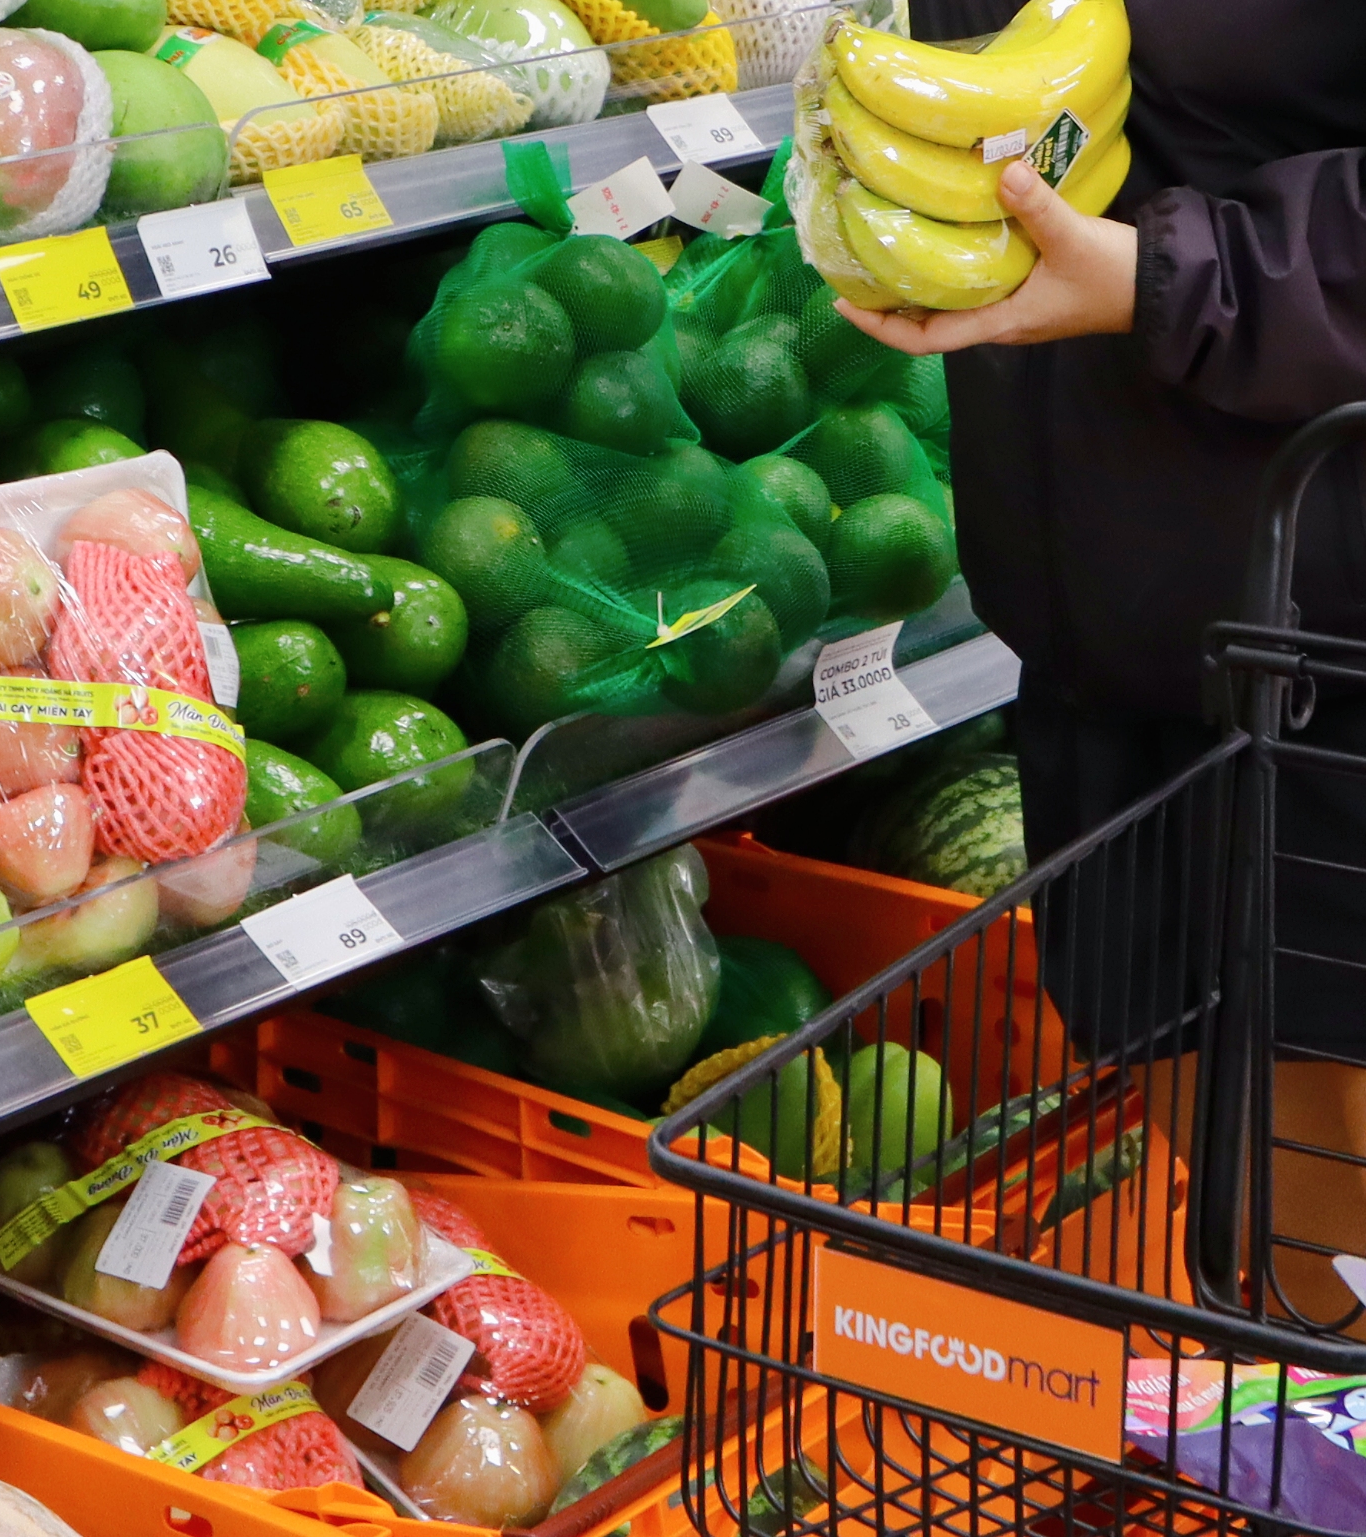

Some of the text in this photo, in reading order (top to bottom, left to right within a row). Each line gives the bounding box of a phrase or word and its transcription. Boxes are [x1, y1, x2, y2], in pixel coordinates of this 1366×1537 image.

[710, 127, 734, 143] 89
[340, 201, 363, 219] 65
[209, 244, 237, 268] 26
[79, 281, 101, 301] 49
[820, 658, 860, 681] COMBO
[861, 655, 870, 668] 2
[817, 667, 893, 704] GIÁ 33.000Đ
[888, 714, 911, 731] 28
[340, 928, 367, 950] 89
[131, 1011, 159, 1035] 37
